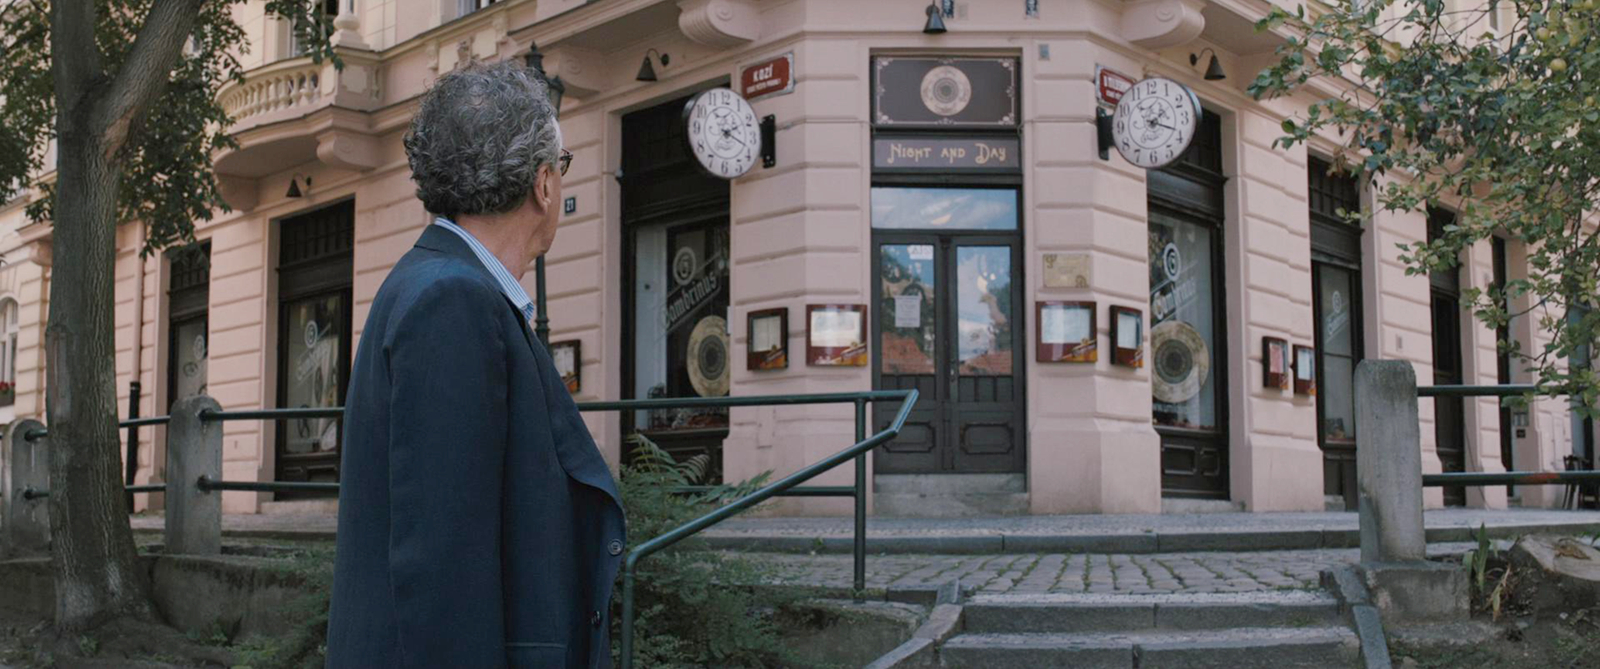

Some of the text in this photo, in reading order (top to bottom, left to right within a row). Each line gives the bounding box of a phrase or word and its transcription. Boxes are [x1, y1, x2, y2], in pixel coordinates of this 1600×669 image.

[753, 63, 773, 82] KOZÍ
[1131, 87, 1140, 101] 11
[1146, 81, 1157, 95] 12
[708, 92, 717, 107] 11
[721, 91, 731, 106] 12
[1175, 94, 1183, 108] 2
[696, 104, 707, 118] 10
[1119, 102, 1130, 118] 10
[746, 113, 752, 127] 2
[1181, 111, 1189, 126] 3
[693, 120, 701, 134] 9
[1117, 120, 1124, 134] 9
[749, 131, 757, 145] 3
[1122, 137, 1130, 151] 8
[1175, 130, 1183, 144] 4
[697, 140, 705, 153] 8
[1166, 144, 1173, 159] 5
[707, 154, 714, 168] 7
[745, 147, 751, 161] 4
[1134, 149, 1141, 163] 7
[1150, 150, 1158, 164] 6
[721, 160, 728, 174] 6
[735, 159, 743, 173] 5
[566, 199, 574, 211] 21
